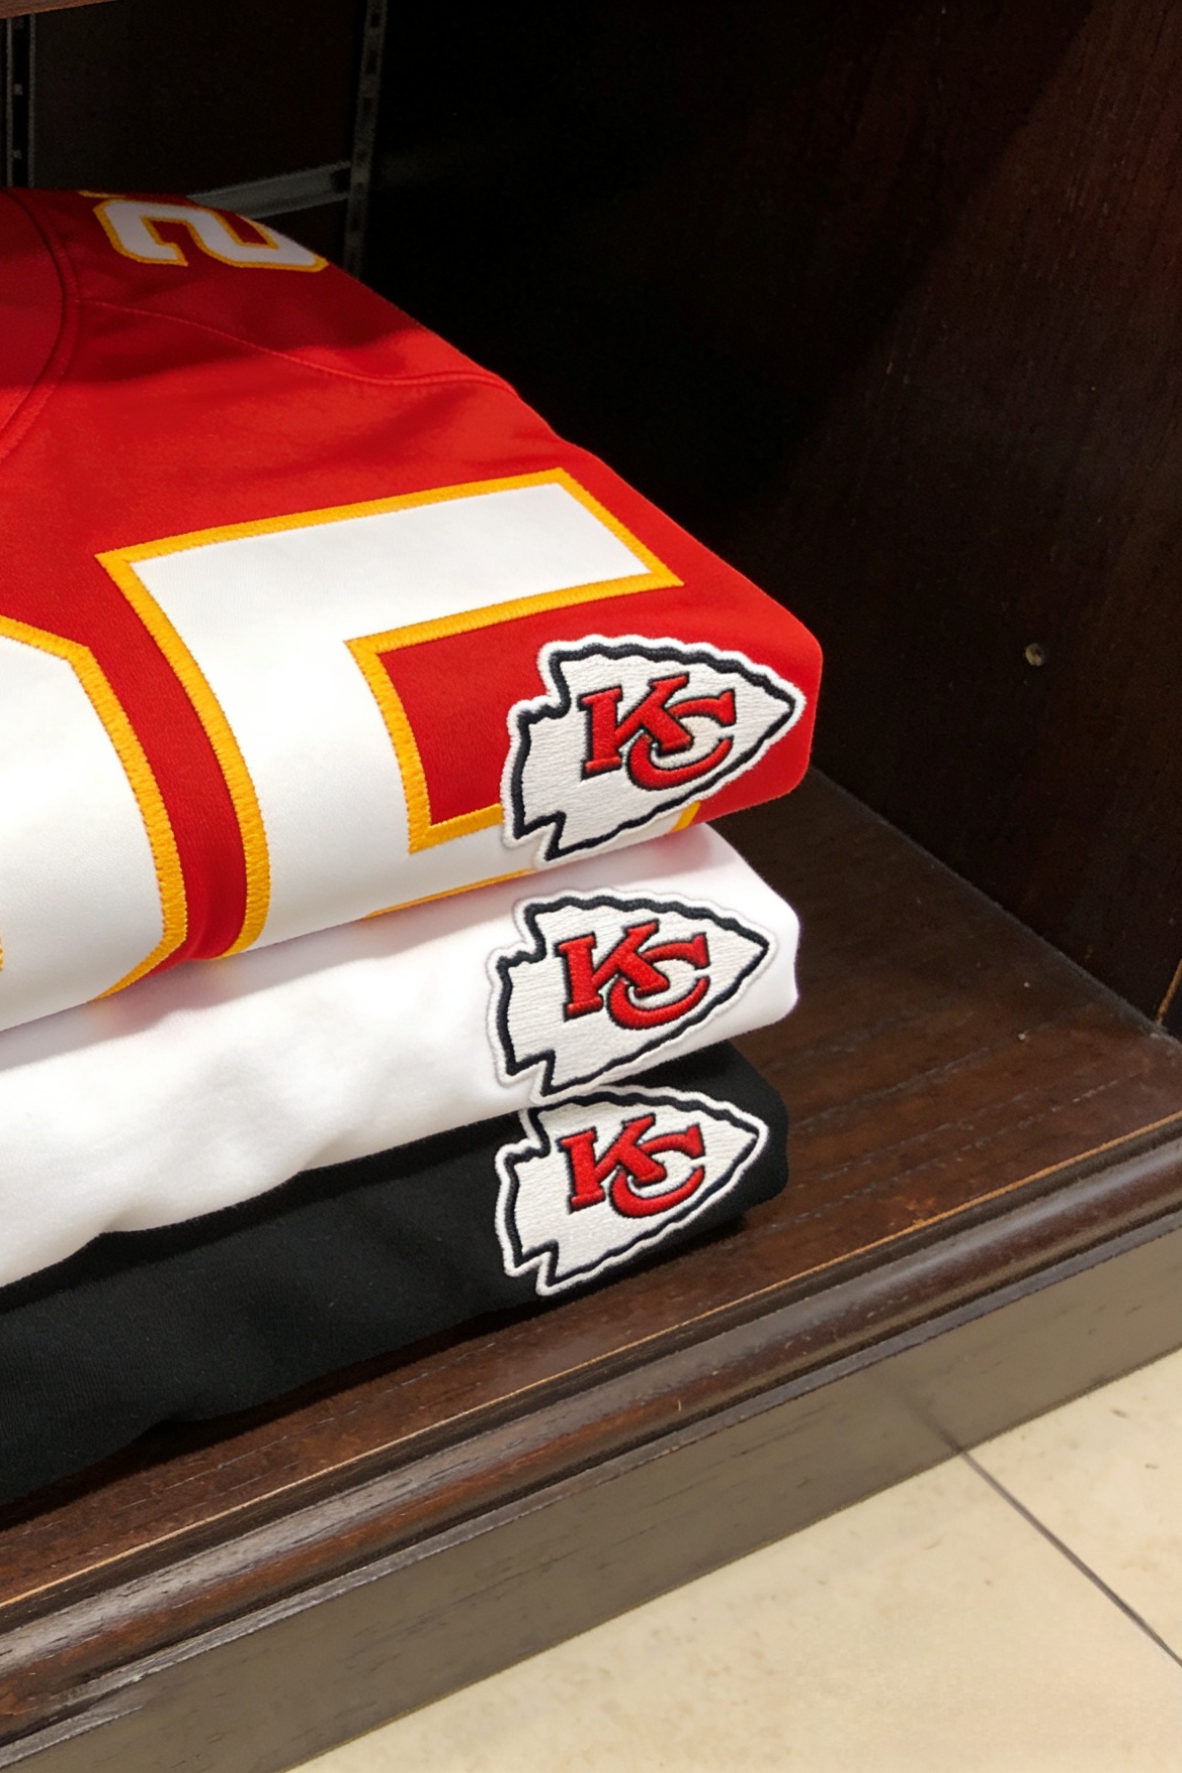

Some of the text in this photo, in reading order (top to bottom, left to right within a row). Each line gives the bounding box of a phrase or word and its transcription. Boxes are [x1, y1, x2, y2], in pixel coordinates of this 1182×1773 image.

[579, 672, 737, 791] KC
[555, 920, 711, 1030] KC
[559, 1112, 706, 1219] KC
